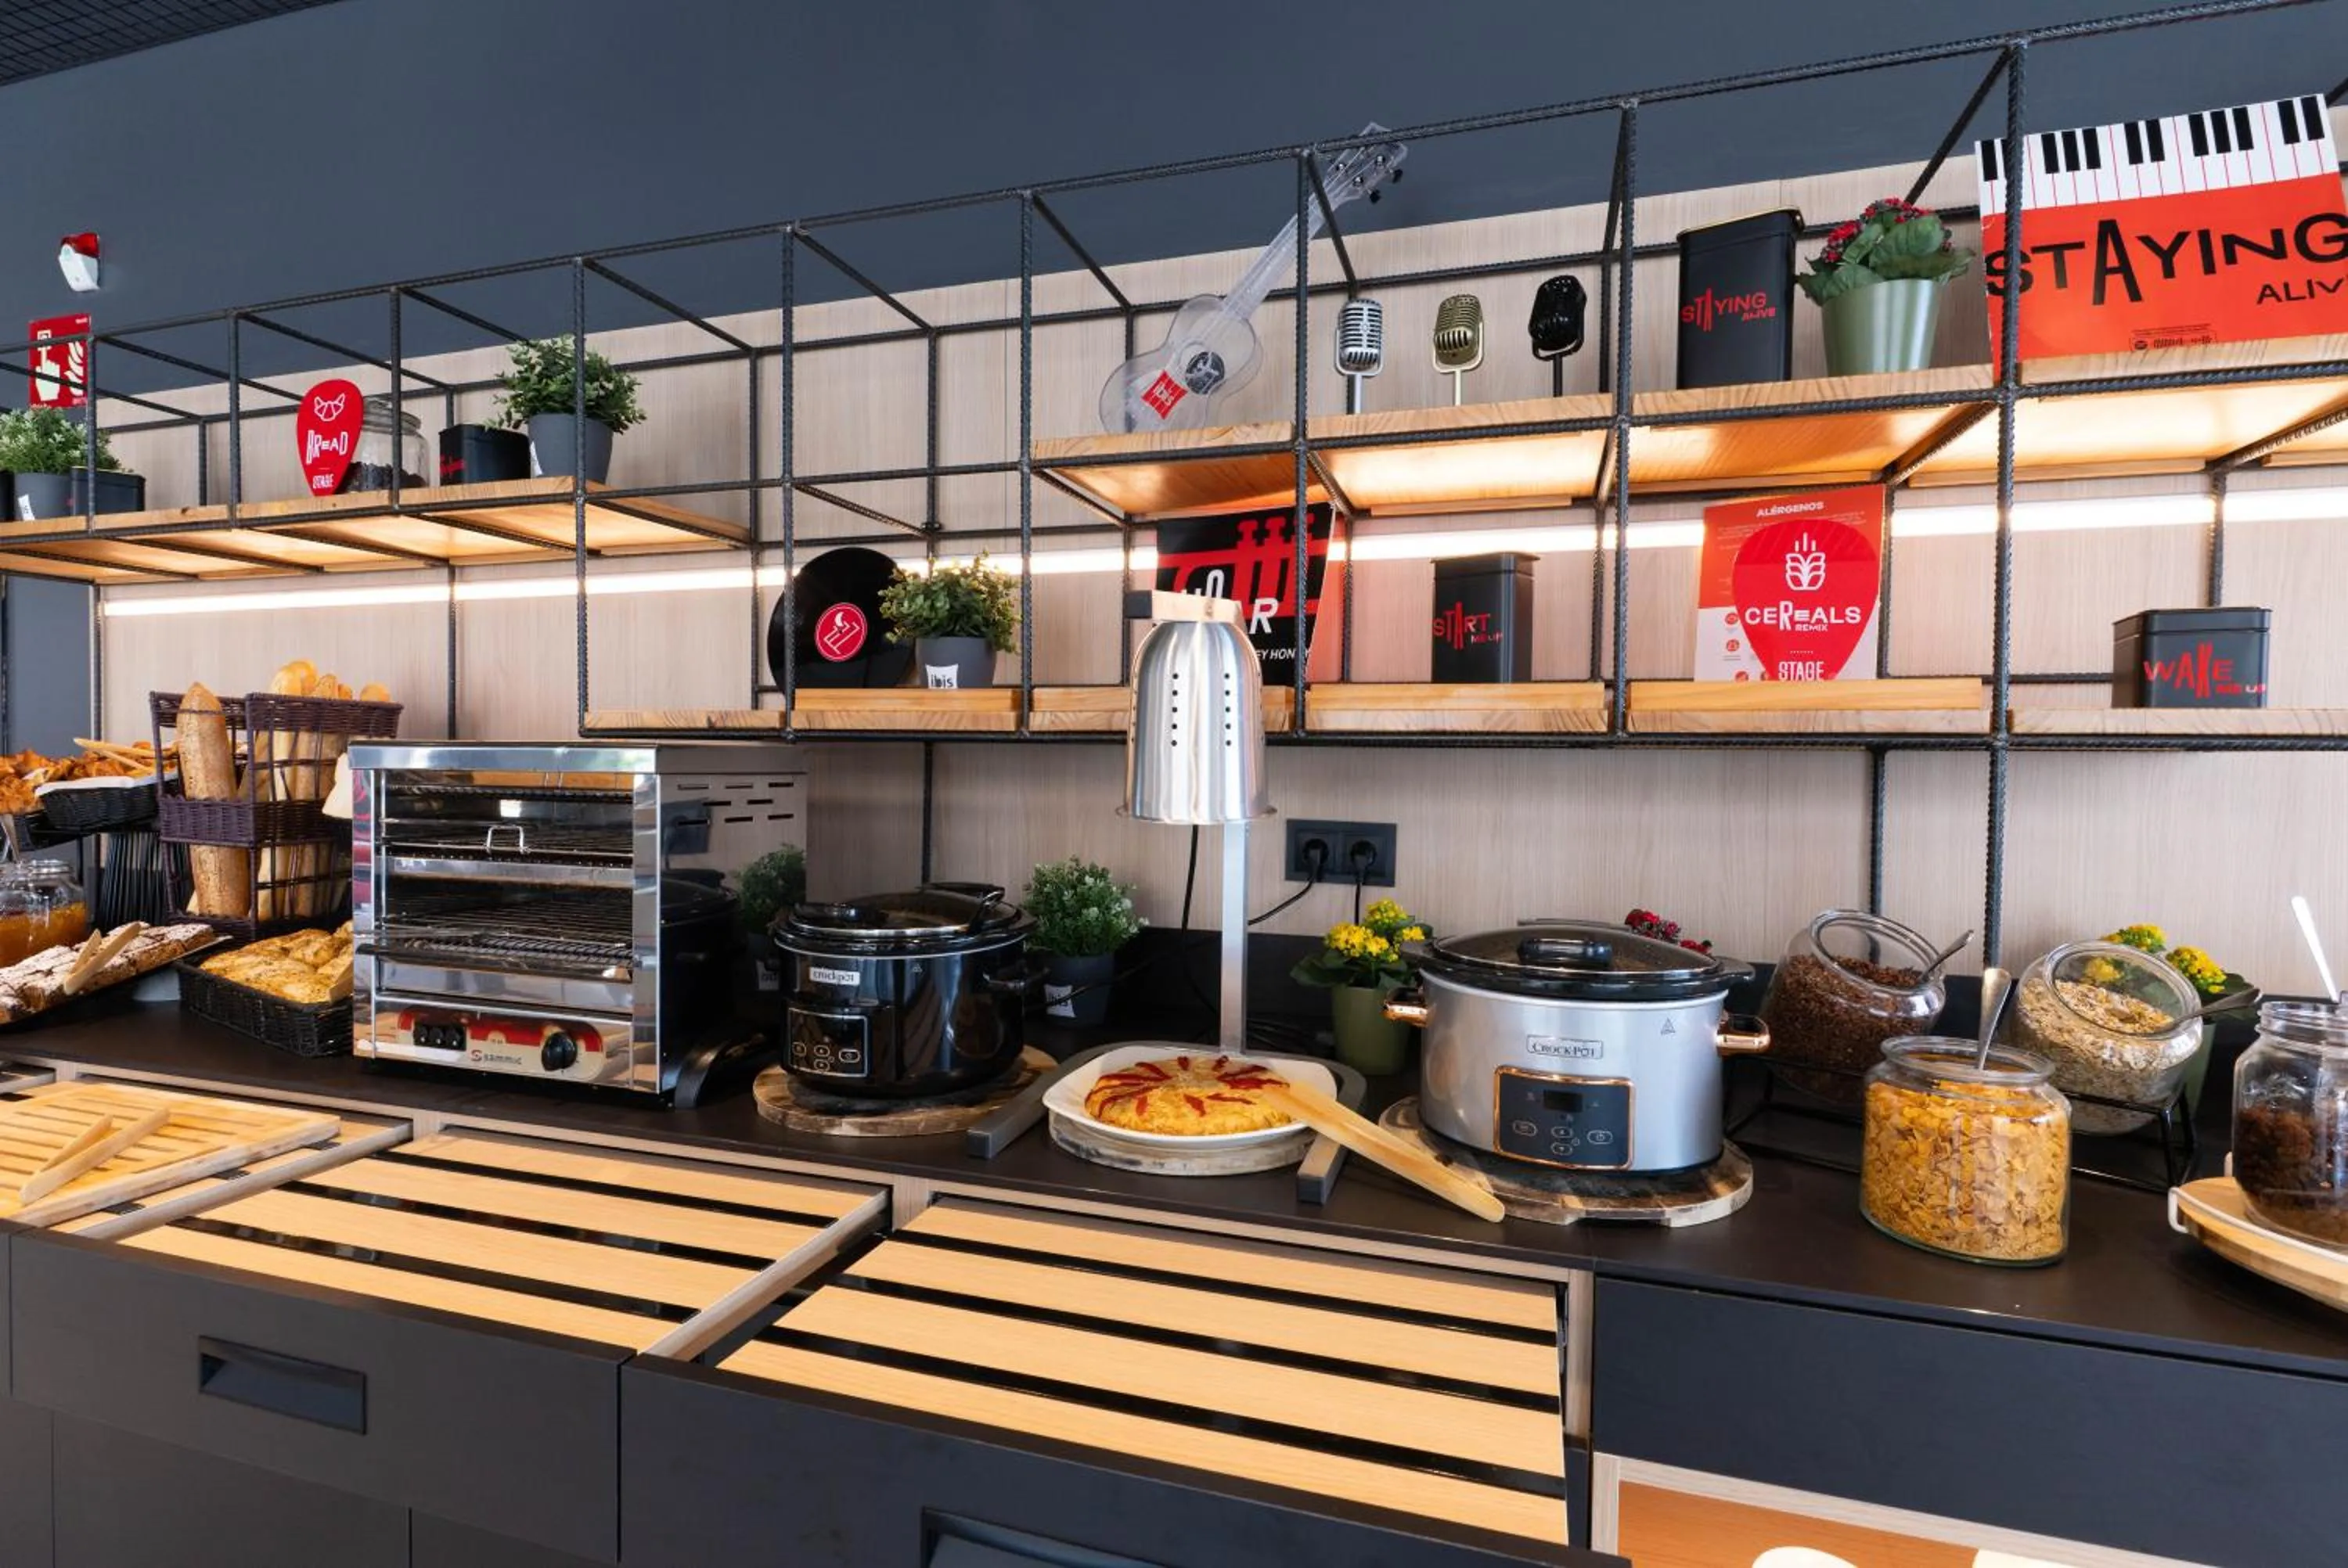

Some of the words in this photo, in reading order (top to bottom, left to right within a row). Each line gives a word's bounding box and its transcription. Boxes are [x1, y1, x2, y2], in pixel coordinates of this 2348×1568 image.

[1986, 212, 2348, 306] STAYING
[2256, 276, 2348, 304] ALIV
[1680, 287, 1766, 333] STAYING
[306, 430, 348, 465] BREAD
[1756, 502, 1824, 517] ALÉRGENOS
[1745, 601, 1861, 631] CEREALS
[931, 674, 953, 688] ibis
[1778, 661, 1824, 681] STAGE
